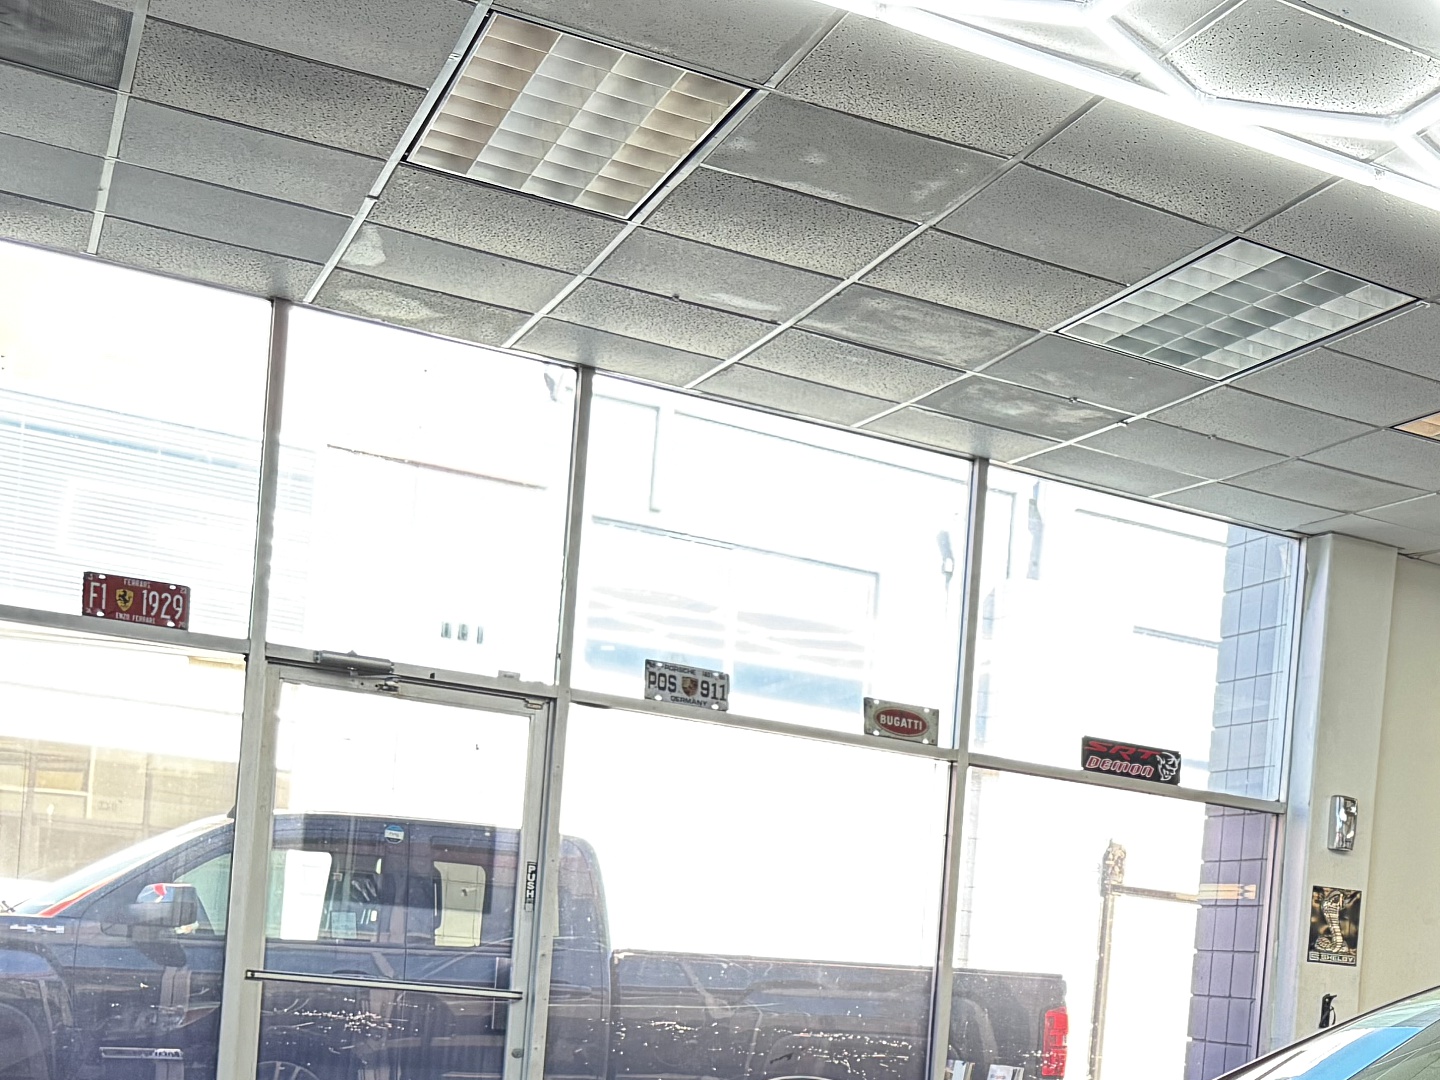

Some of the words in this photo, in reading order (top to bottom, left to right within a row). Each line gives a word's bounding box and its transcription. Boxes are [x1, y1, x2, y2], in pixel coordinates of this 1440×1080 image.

[89, 581, 107, 610] F1
[142, 589, 183, 620] 1929
[648, 671, 677, 693] POS
[700, 680, 726, 701] 911
[670, 696, 708, 706] GERMANY
[880, 714, 923, 731] BUGATTI
[1084, 740, 1162, 761] SRT
[526, 865, 536, 898] PUSH
